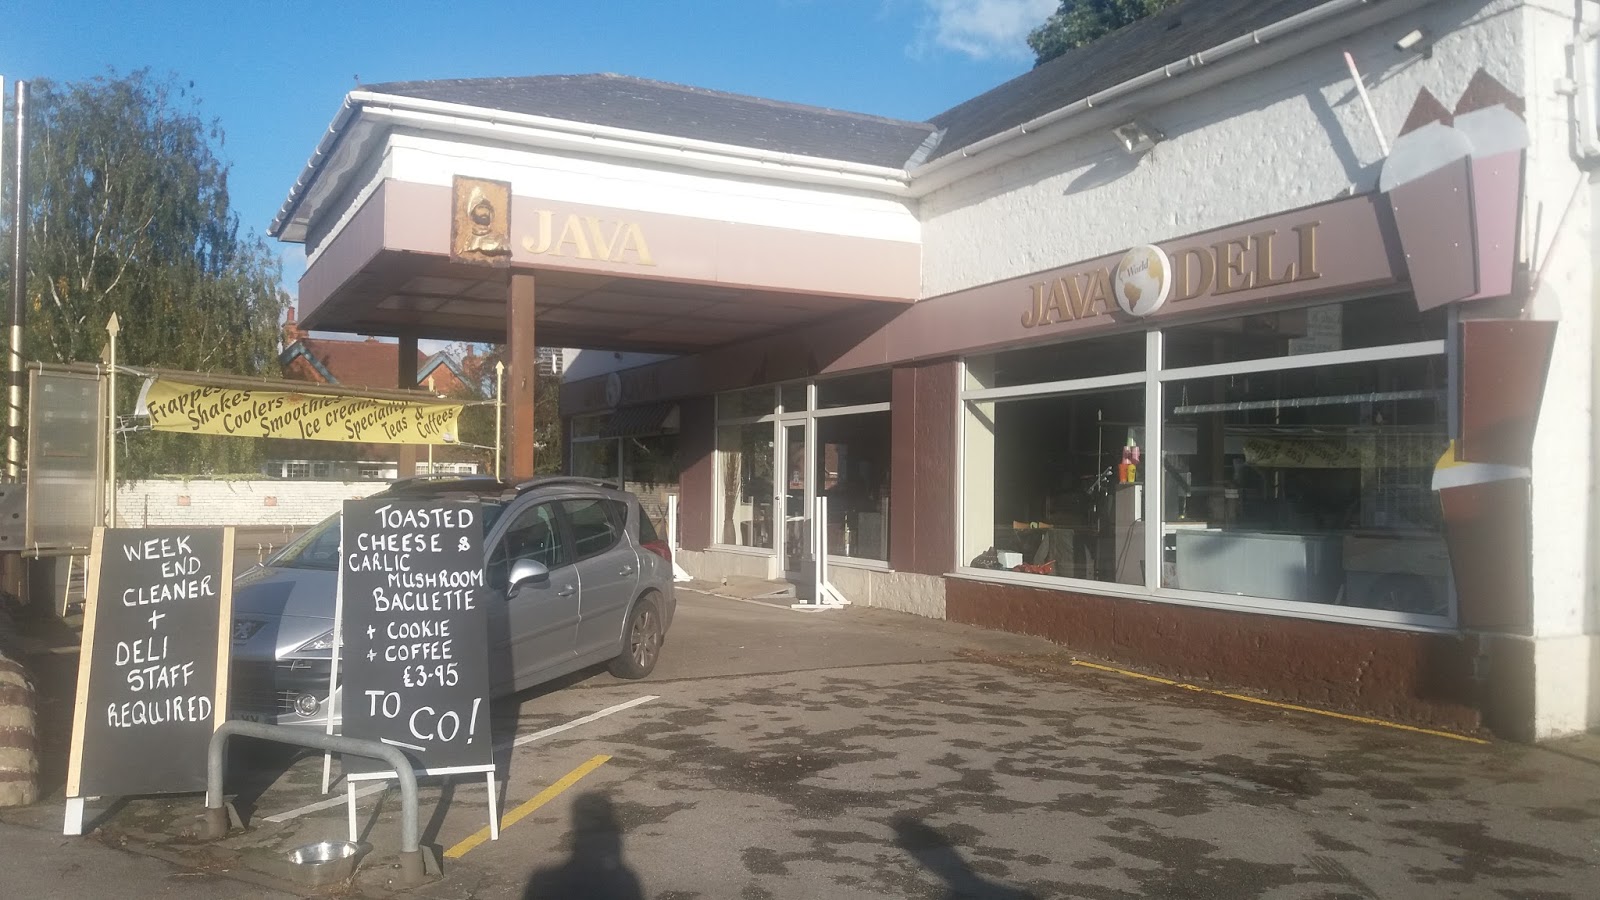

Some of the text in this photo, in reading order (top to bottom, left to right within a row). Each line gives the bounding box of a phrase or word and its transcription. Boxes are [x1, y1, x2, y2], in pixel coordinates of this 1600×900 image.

[522, 209, 657, 266] JAVA
[1021, 220, 1322, 328] JAVA DELI
[1127, 257, 1149, 277] World
[147, 386, 222, 424] Frappes
[187, 389, 251, 431] Shakes
[223, 396, 284, 434] Coolers
[260, 395, 344, 438] Smoothies
[299, 417, 321, 440] Ice
[381, 406, 424, 440] Teas &
[416, 408, 454, 439] Coffees
[375, 504, 474, 529] TOASTED
[123, 535, 192, 561] WEEK
[357, 533, 443, 552] CHEESE
[162, 556, 201, 578] END
[348, 553, 411, 572] GARLIC
[123, 575, 216, 607] CLEANER
[388, 568, 484, 588] MUSHROOM
[372, 586, 476, 612] BAGUETTE
[387, 619, 450, 640] COOKIE
[115, 636, 168, 666] DELI
[384, 639, 453, 662] COFFEE
[127, 661, 194, 692] STAFF
[107, 696, 212, 728] REQUIRED
[364, 690, 401, 719] TO
